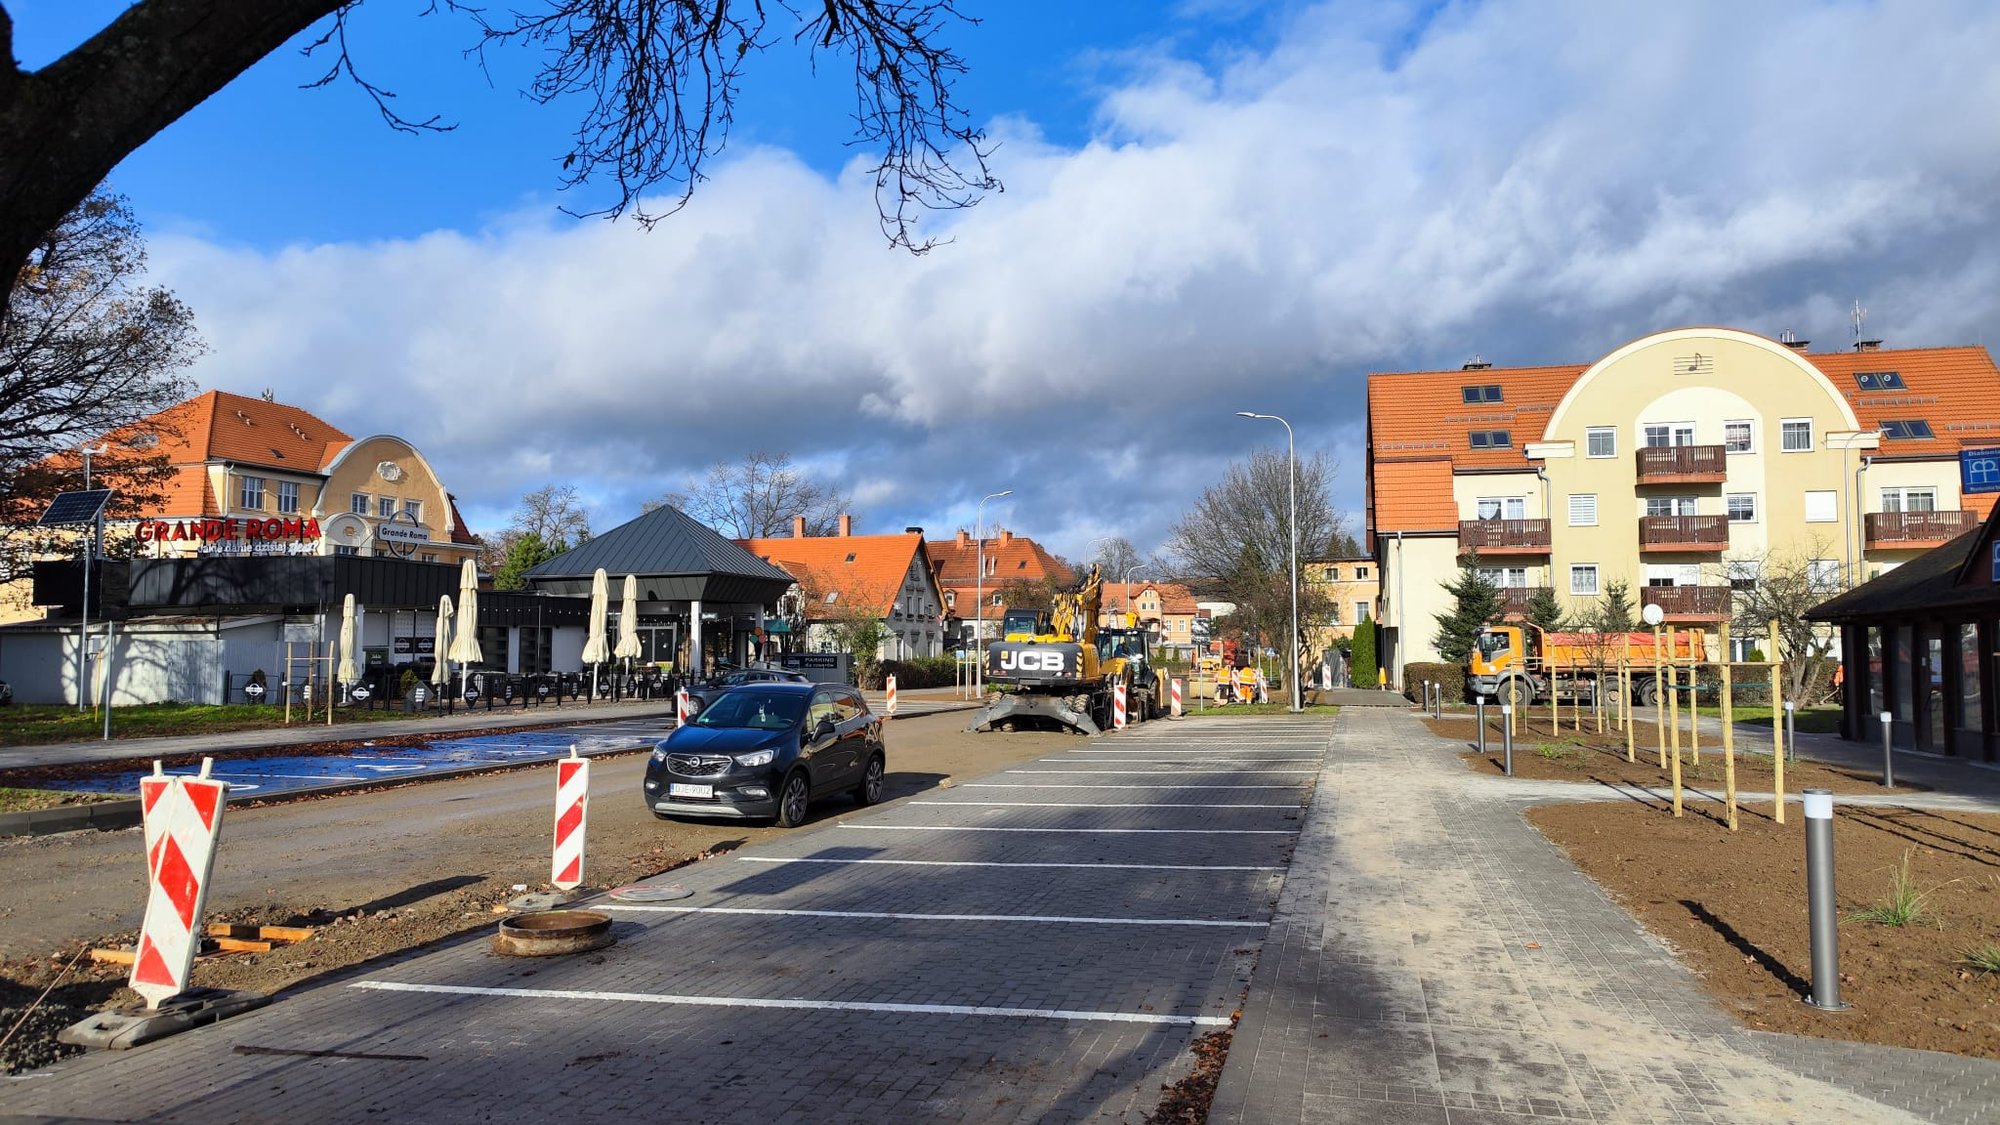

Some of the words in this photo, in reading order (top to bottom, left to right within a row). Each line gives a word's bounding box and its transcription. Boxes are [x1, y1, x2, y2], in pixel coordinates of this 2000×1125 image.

[135, 519, 240, 543] GRANDE
[245, 517, 322, 541] ROMA
[382, 527, 408, 538] Grande
[409, 530, 428, 540] Roma
[198, 543, 223, 554] Jakie
[224, 542, 253, 553] danie
[255, 540, 287, 554] dzisiaj
[1000, 650, 1065, 671] JCB
